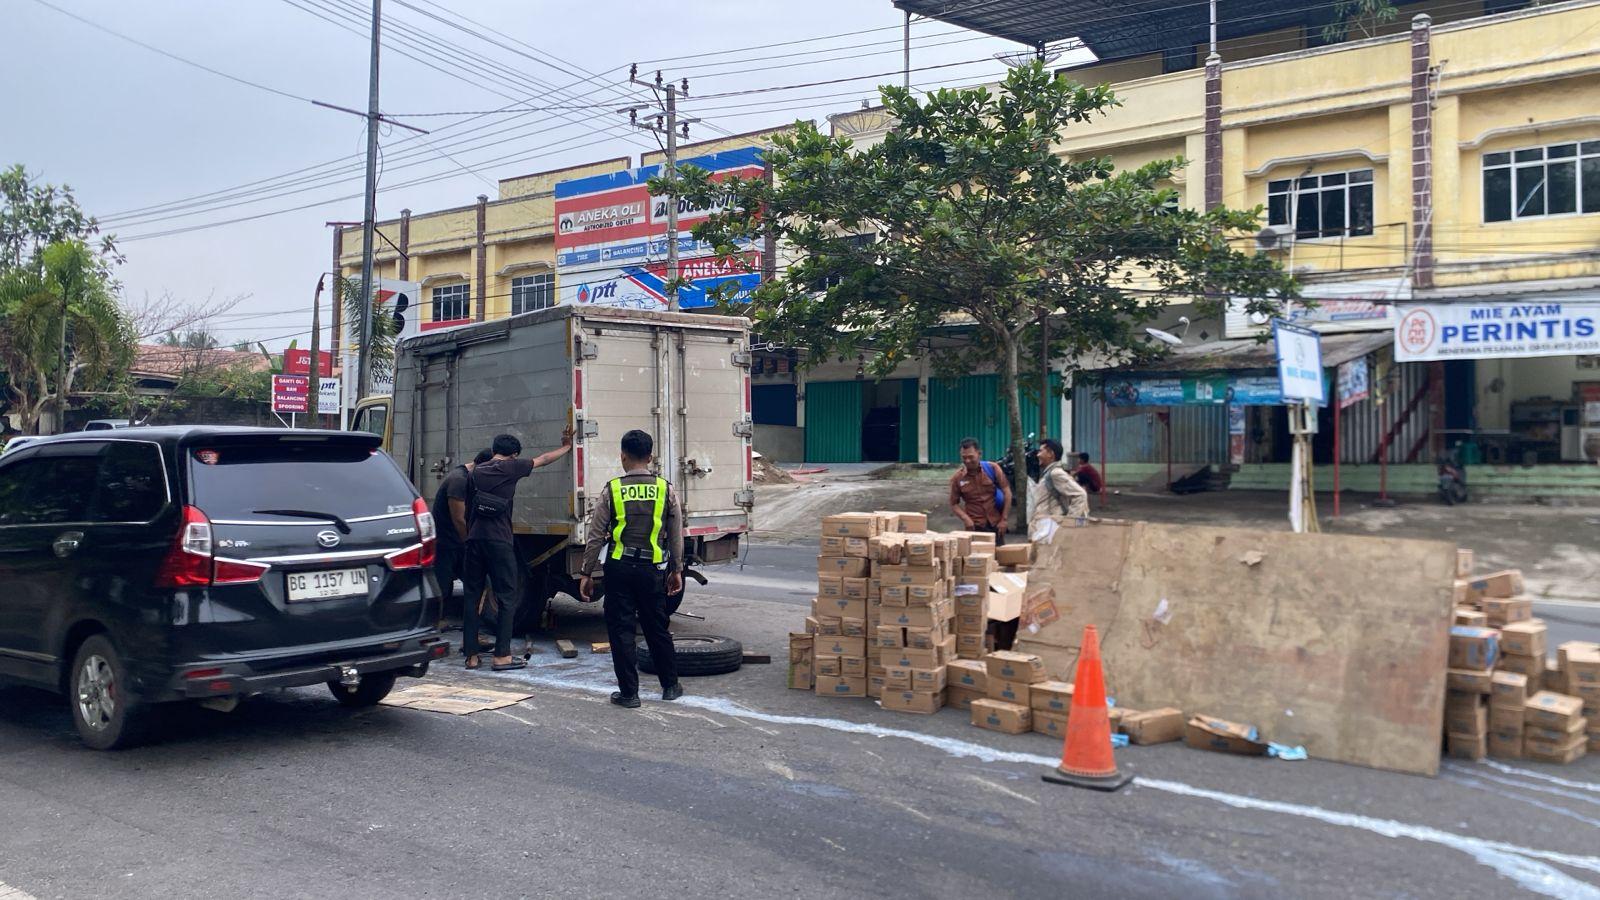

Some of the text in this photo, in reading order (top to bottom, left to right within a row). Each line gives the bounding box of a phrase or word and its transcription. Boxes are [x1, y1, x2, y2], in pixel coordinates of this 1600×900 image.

[577, 205, 640, 223] ANEKA OLI
[583, 222, 613, 232] AUTHORIZED
[616, 218, 634, 226] OUTLET
[613, 246, 644, 256] BALANCING
[683, 260, 732, 278] ANEKA
[590, 281, 618, 303] ptt
[1471, 304, 1561, 320] MIE AYAM
[1441, 318, 1595, 344] PERINTIS
[321, 382, 336, 390] ptt
[621, 484, 659, 500] POLISI
[289, 570, 366, 591] BG 1157 UN
